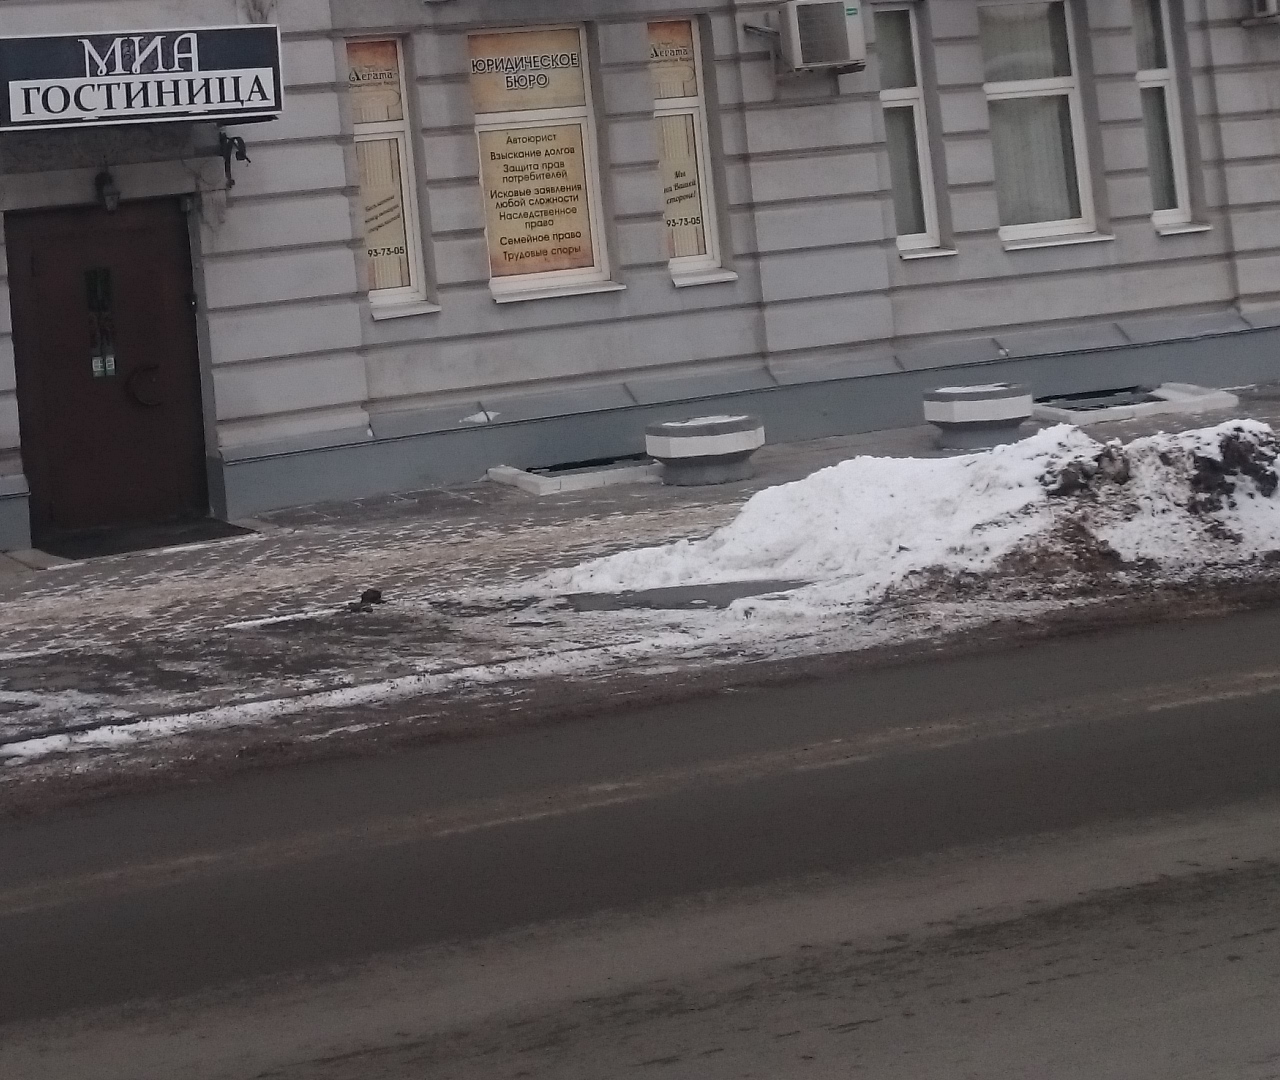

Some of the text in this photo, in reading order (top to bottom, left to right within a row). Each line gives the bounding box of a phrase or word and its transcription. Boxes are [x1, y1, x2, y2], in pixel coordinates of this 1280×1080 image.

[78, 32, 200, 78] МИА
[471, 52, 579, 73] ЮРИДИЧЕСКОЕ
[505, 73, 549, 89] БЮРО
[20, 73, 272, 116] ГОСТИНИЦА
[506, 133, 557, 146] Автоюрист
[490, 146, 575, 161] Взыскание долгов
[503, 160, 565, 174] Защита прав
[502, 170, 568, 184] потребителей
[490, 183, 582, 200] Исковые заявления
[495, 194, 579, 210] любой сложности
[499, 206, 578, 221] Наследственное
[524, 218, 554, 230] право
[666, 217, 701, 228] 93-73-05
[500, 230, 582, 246] Семейное право
[367, 246, 405, 258] 93-73-05
[503, 245, 581, 262] Трудовые споры
